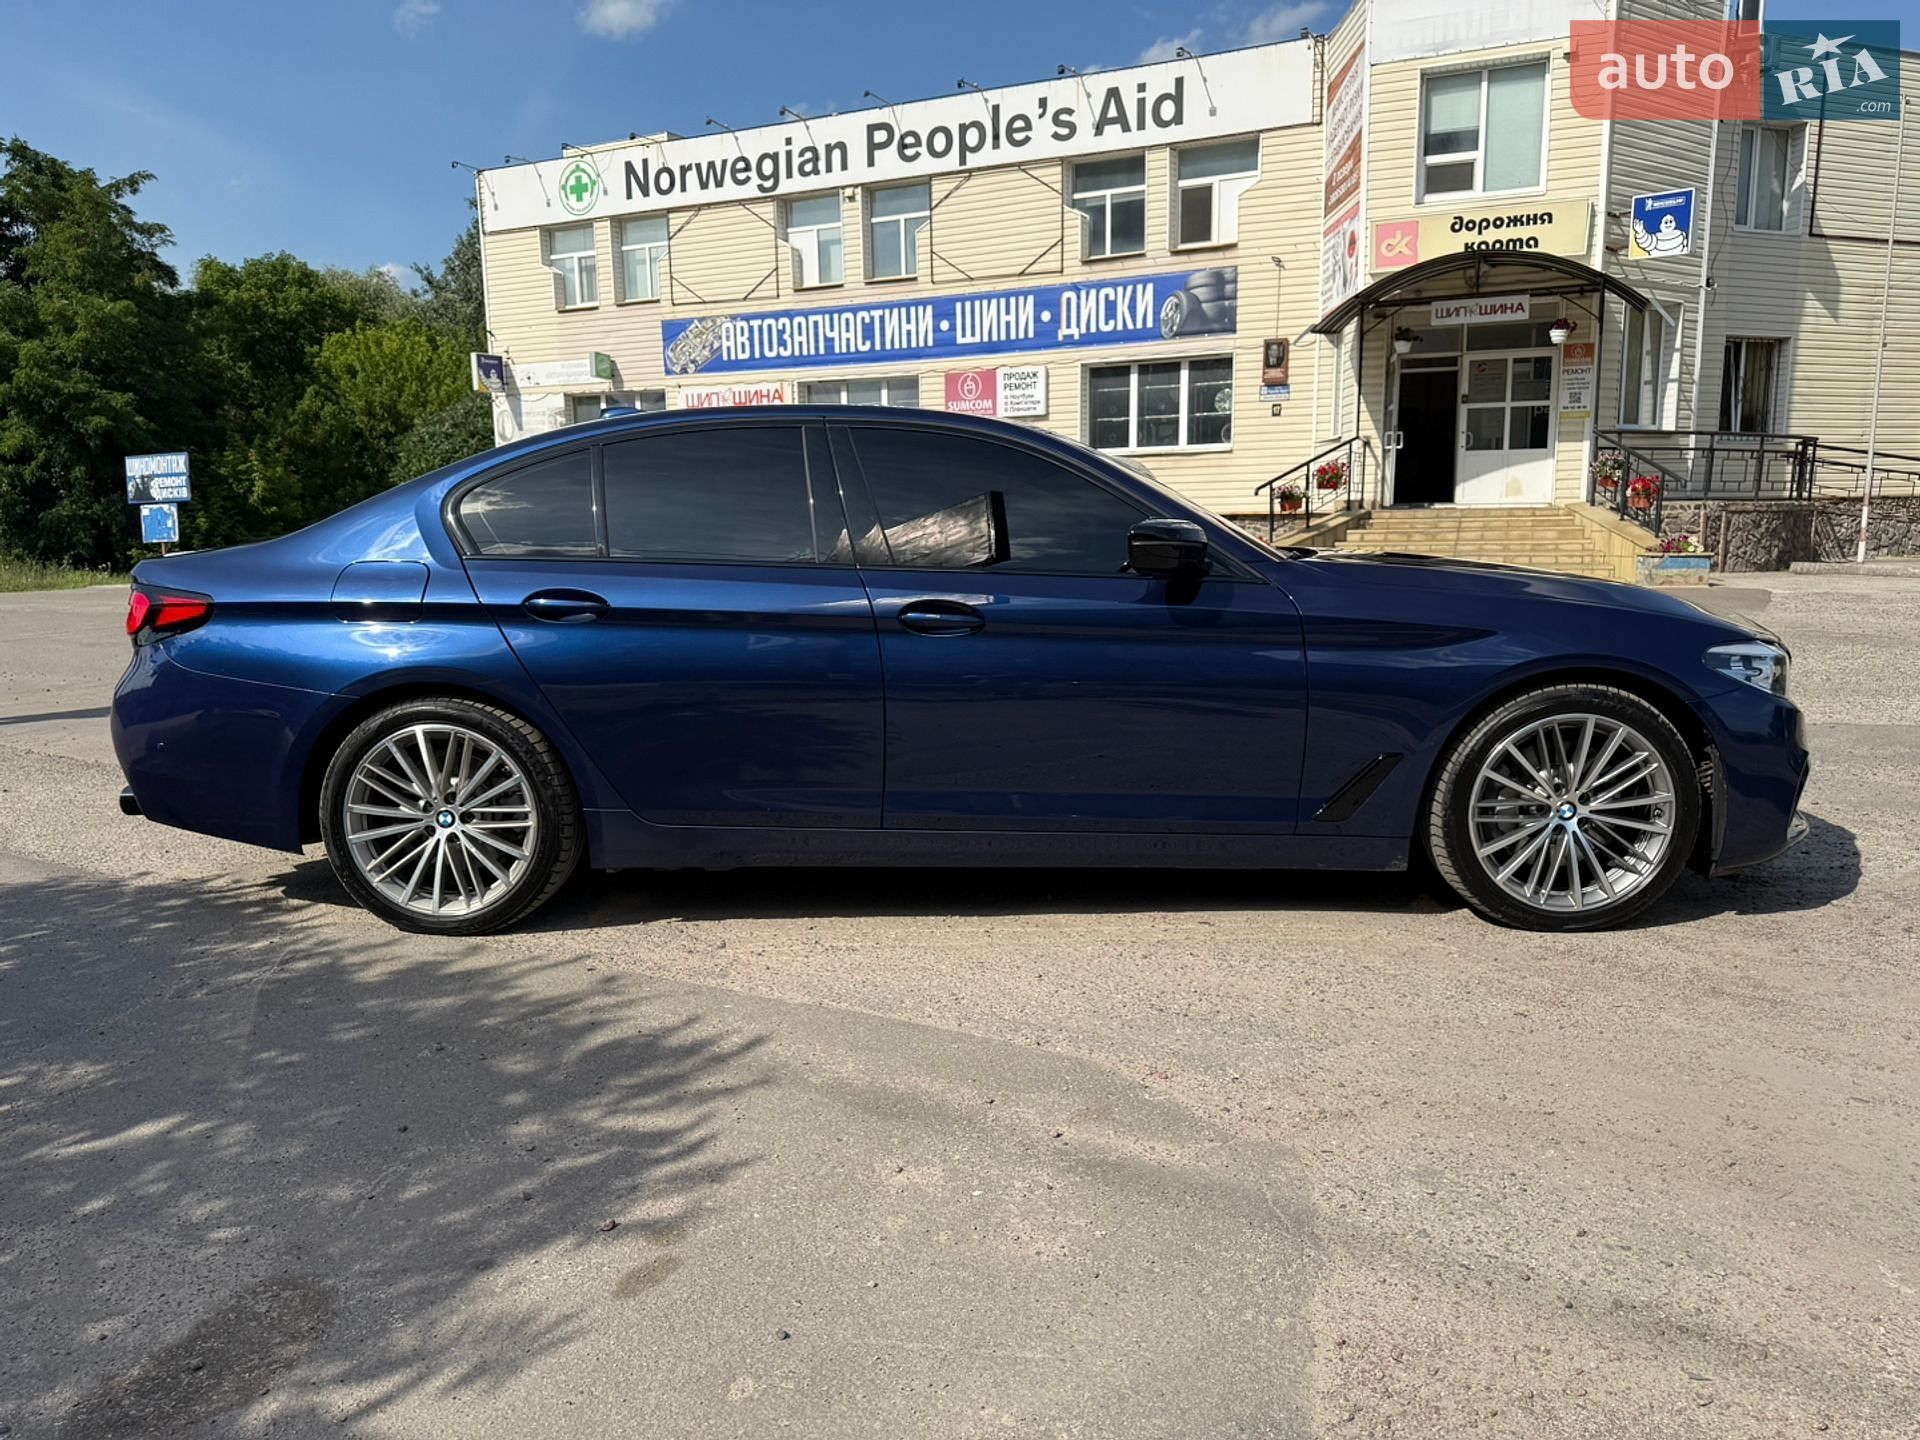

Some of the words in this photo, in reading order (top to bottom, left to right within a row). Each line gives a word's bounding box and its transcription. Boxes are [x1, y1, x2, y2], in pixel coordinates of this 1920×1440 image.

[624, 136, 849, 201] Norwegian
[1094, 75, 1185, 137] Aid
[1450, 211, 1554, 236] дорожня
[720, 304, 934, 361] АВТОЗАПЧАСТИНИ
[955, 294, 1035, 345] ШИНИ
[1057, 282, 1154, 341] ДИСКИ
[1003, 370, 1039, 382] ПРОДАЖ
[1003, 381, 1038, 392] РЕМОНТ
[947, 399, 993, 411] SUMCOM
